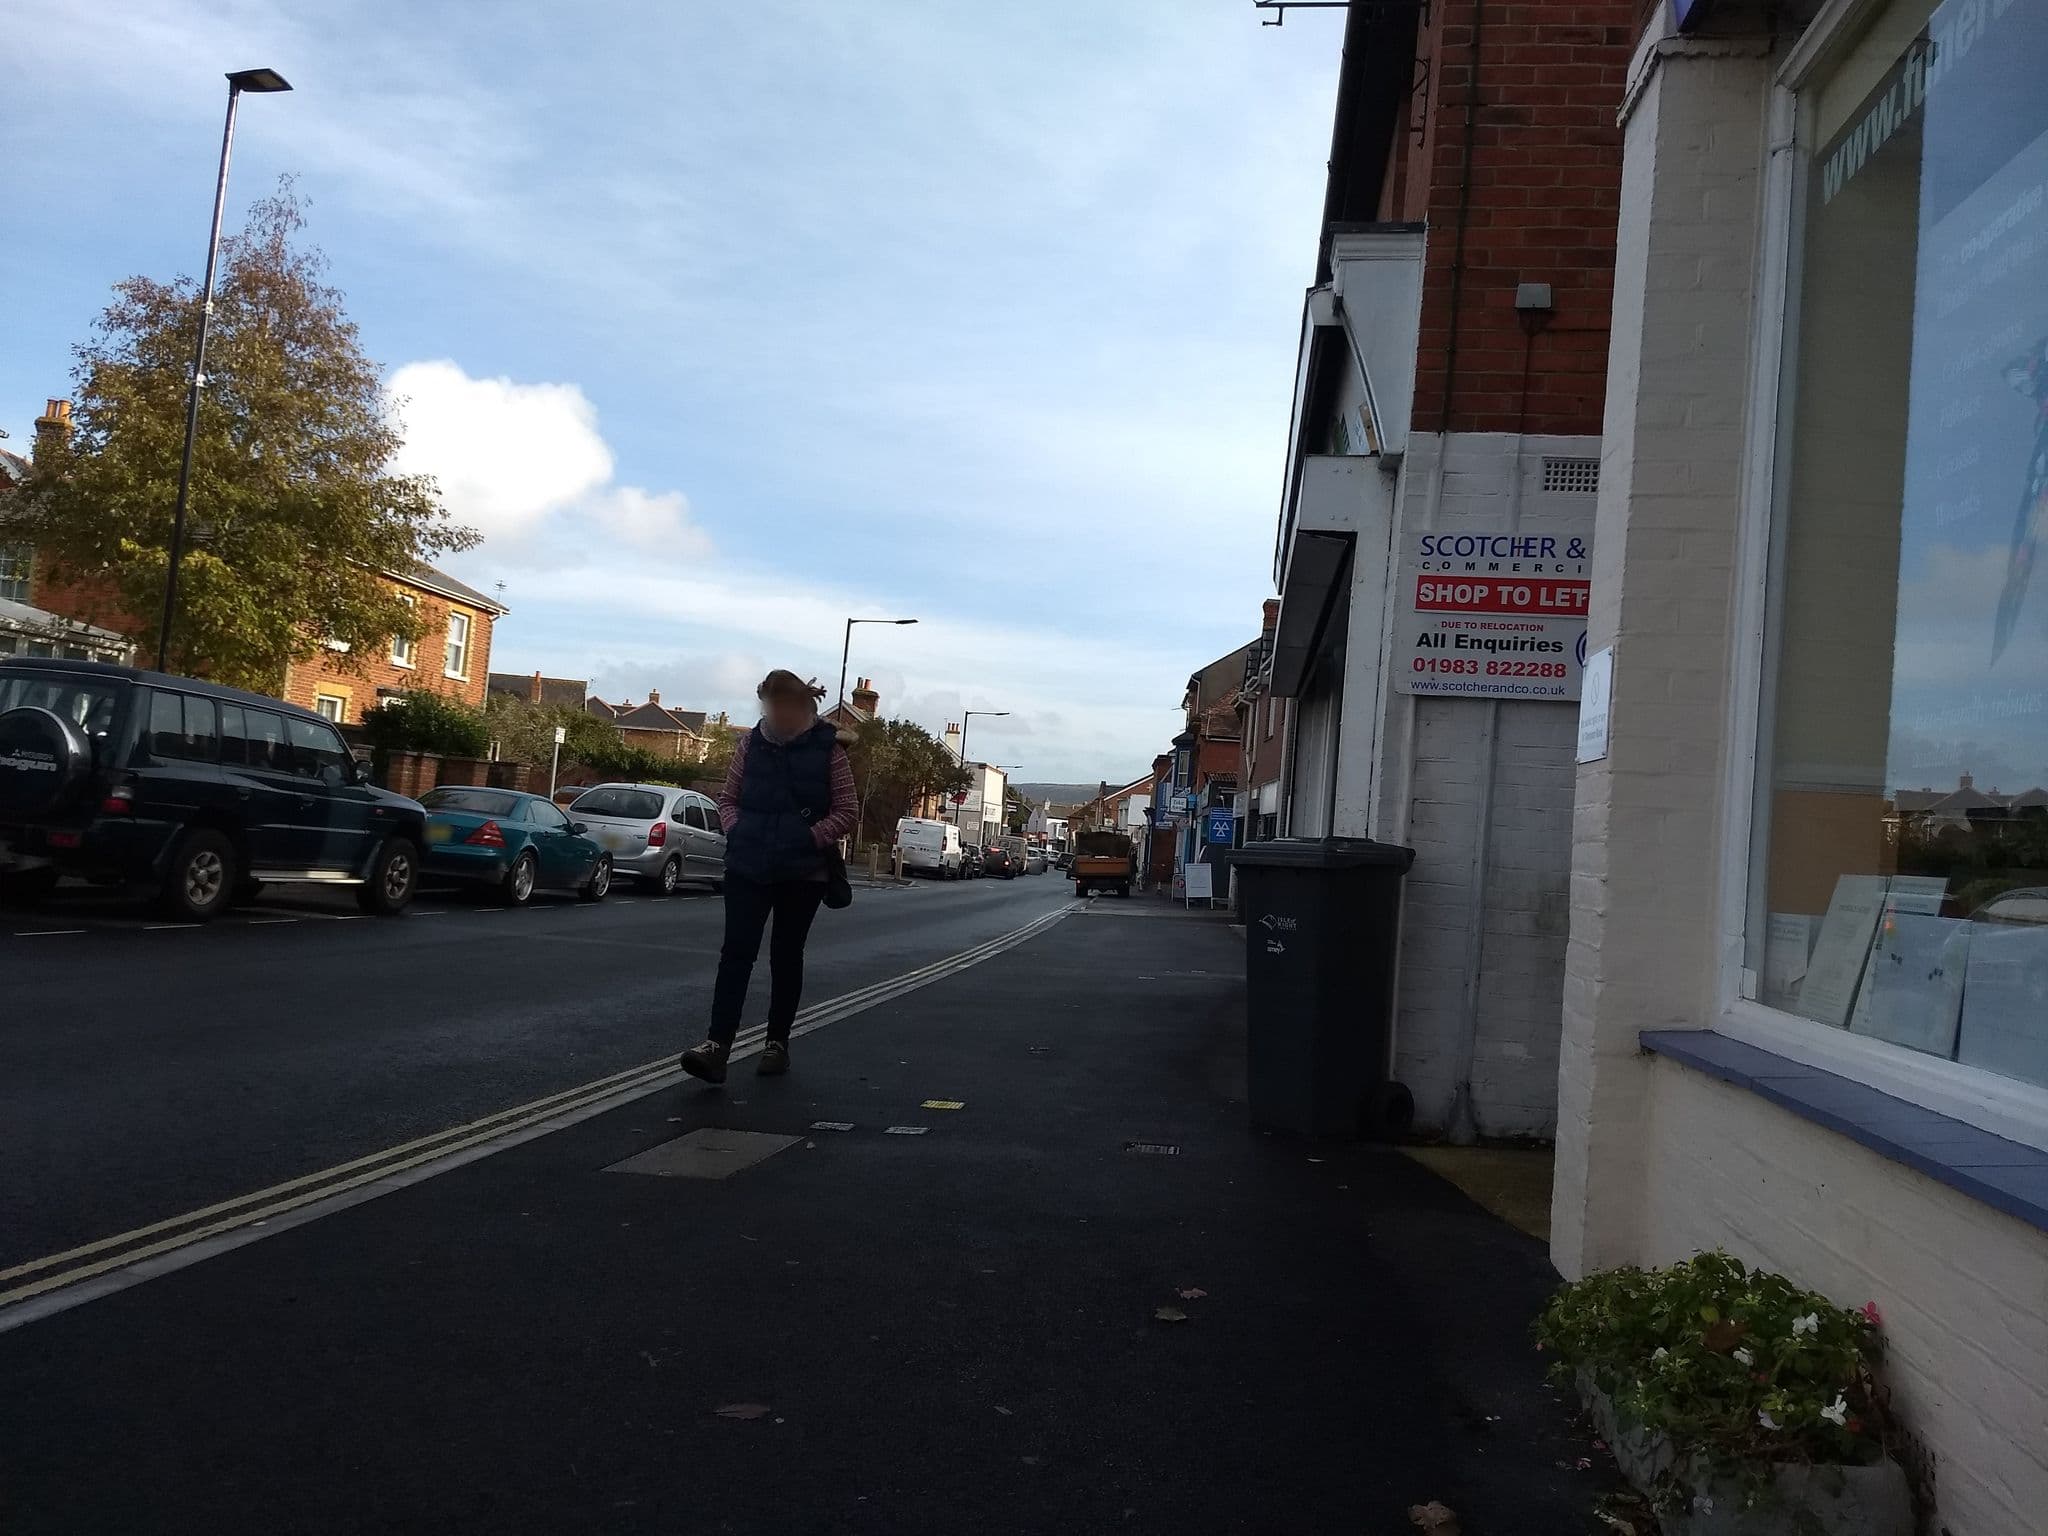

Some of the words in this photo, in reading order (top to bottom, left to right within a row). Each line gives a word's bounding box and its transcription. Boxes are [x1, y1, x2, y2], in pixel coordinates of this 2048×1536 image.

[1420, 535, 1556, 559] SCOTCHER
[1566, 537, 1587, 560] &
[1419, 583, 1489, 604] SHOP
[1497, 586, 1531, 606] TO
[1539, 587, 1588, 607] LET
[1441, 621, 1461, 630] DUE
[1464, 622, 1478, 630] TO
[1480, 623, 1544, 632] RELOCATION
[1416, 632, 1447, 649] All
[1454, 634, 1564, 654] Enquiries
[1413, 657, 1479, 675] 01983
[1486, 661, 1567, 679] 822288
[1411, 680, 1565, 696] www.scotcherandco.co.uk
